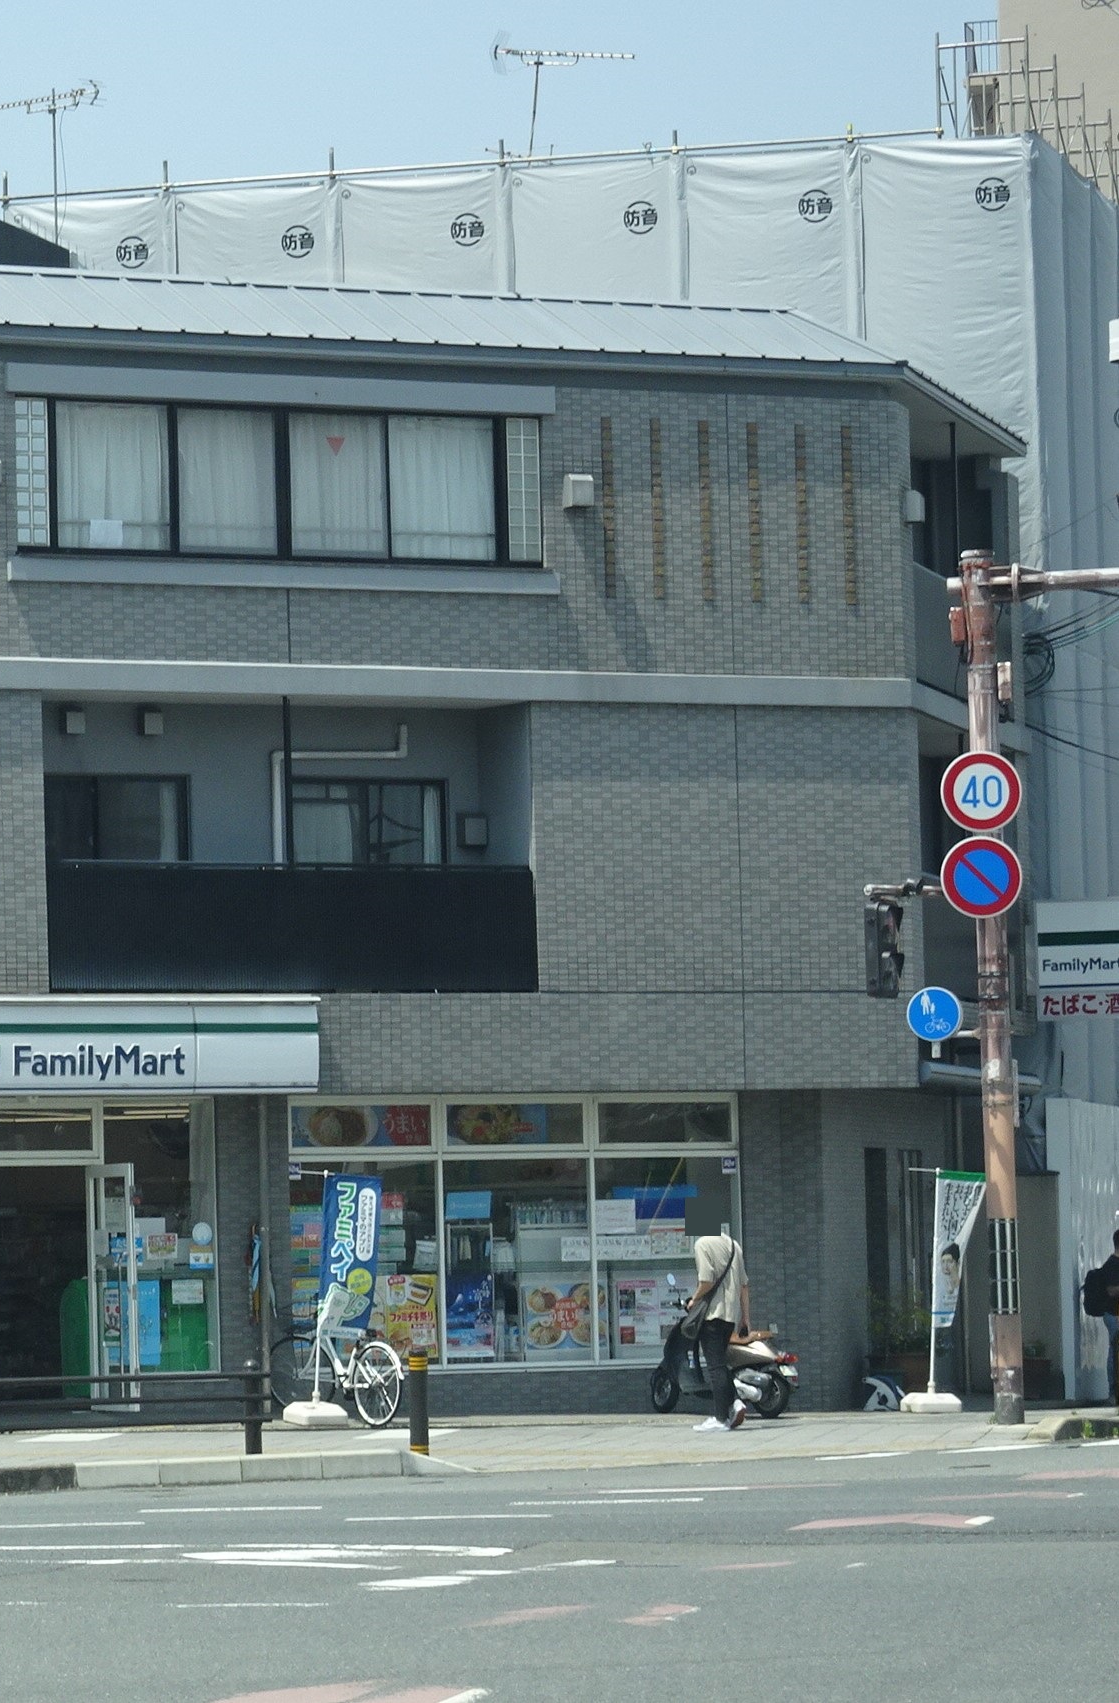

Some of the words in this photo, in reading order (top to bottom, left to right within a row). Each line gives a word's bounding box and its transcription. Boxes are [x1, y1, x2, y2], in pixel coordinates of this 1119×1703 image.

[976, 184, 1011, 204] 防音
[799, 196, 832, 216] 防音
[624, 207, 658, 228] 防音
[451, 220, 485, 239] 防音
[283, 231, 315, 251] 防音
[117, 242, 149, 262] 防音
[961, 774, 1003, 808] 40
[13, 1044, 186, 1081] FamilyMart
[331, 1182, 357, 1282] ファミペイ
